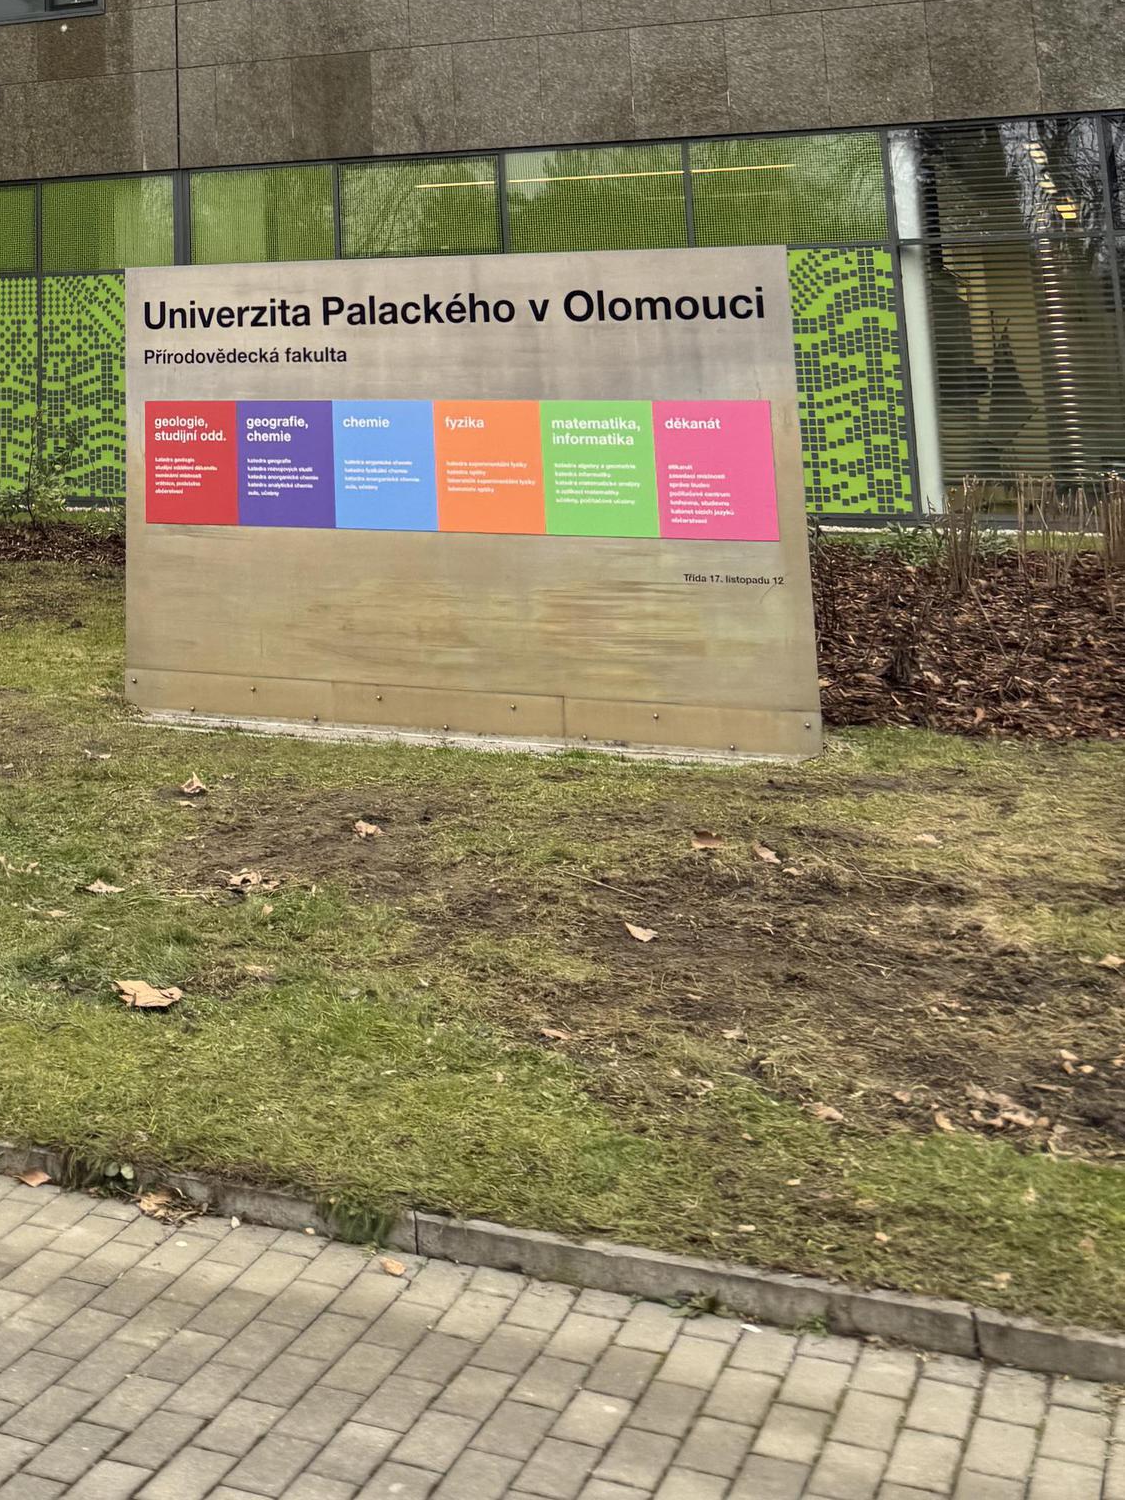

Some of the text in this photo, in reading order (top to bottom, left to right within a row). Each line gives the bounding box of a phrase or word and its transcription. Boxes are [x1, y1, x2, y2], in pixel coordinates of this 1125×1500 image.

[144, 286, 765, 330] Univerzita Palackého v Olomouci
[144, 346, 347, 365] Přírodovědecká fakulta
[154, 416, 208, 428] geologie,
[246, 416, 309, 429] geografie,
[342, 416, 390, 428] chemie
[445, 416, 485, 430] fyzika
[551, 417, 641, 431] matematika,
[665, 417, 721, 429] děkanát
[154, 430, 226, 443] studijní odd.
[246, 430, 291, 442] chemie
[552, 433, 634, 445] informatika
[683, 573, 784, 585] Třída 17. listopadu 12
